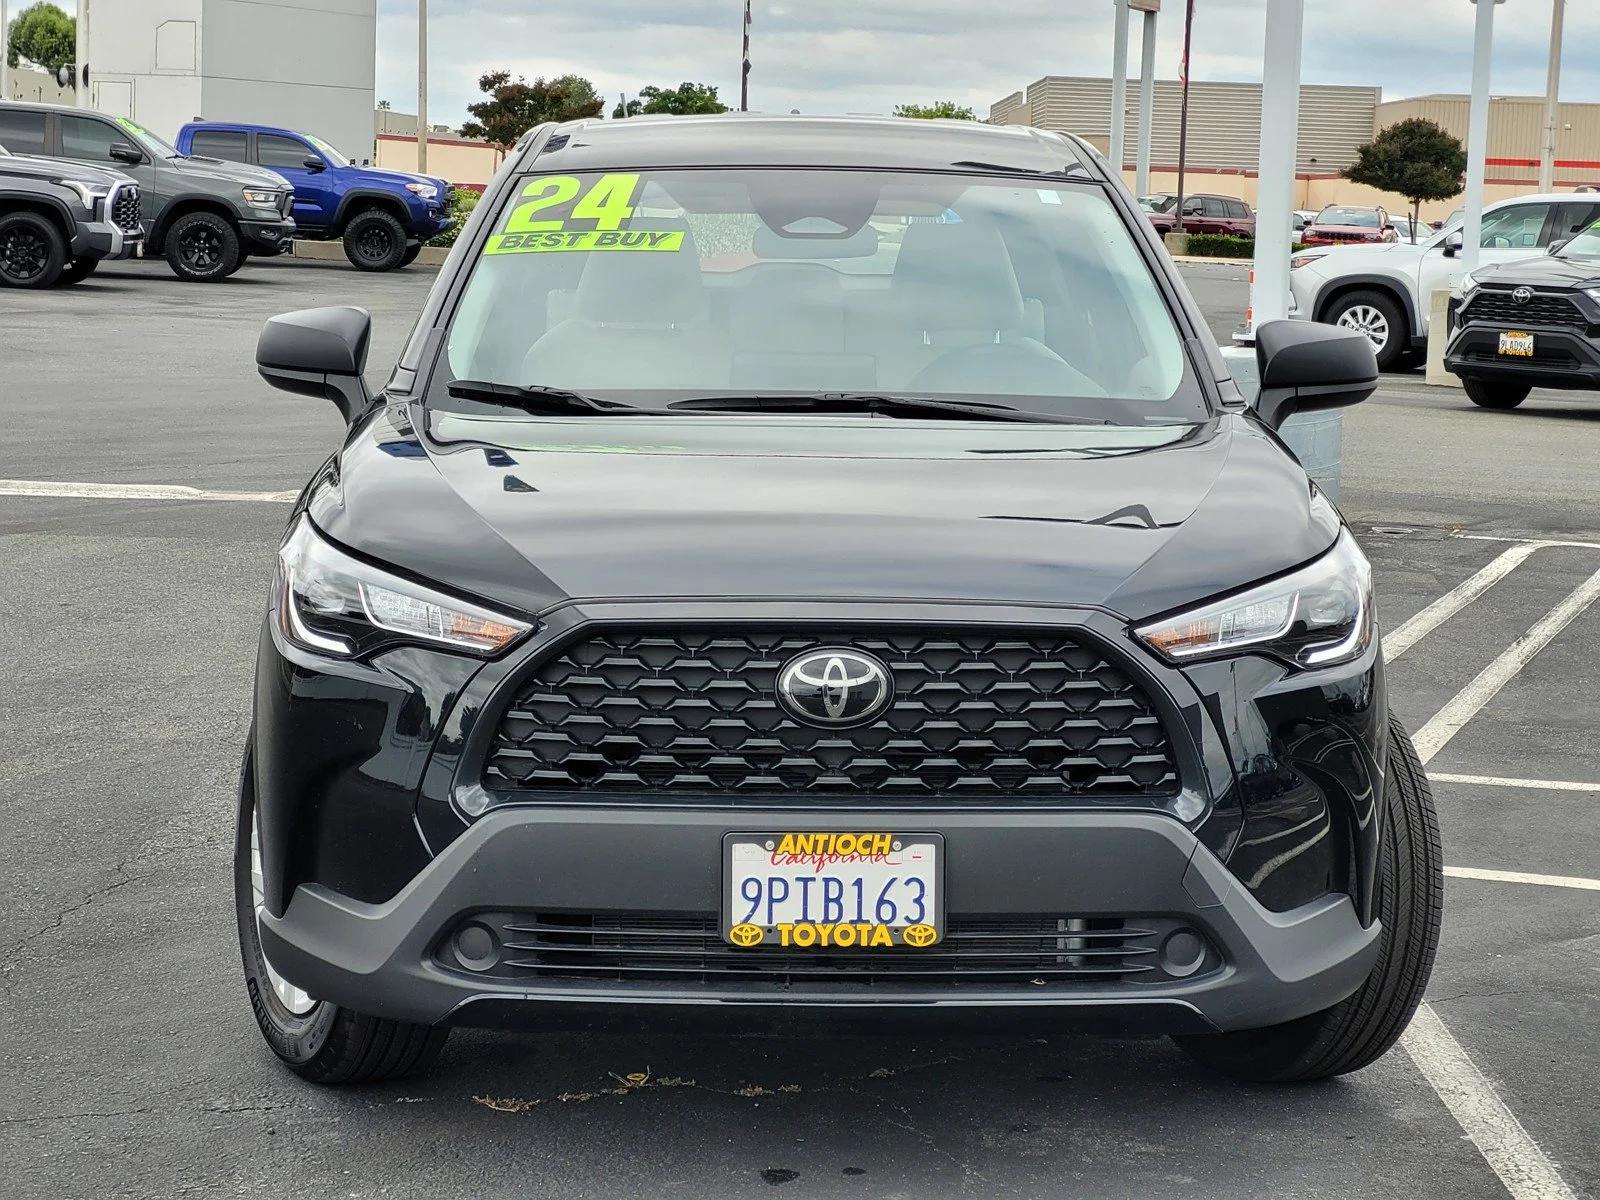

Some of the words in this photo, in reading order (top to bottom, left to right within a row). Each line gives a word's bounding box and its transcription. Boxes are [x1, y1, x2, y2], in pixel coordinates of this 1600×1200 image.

[504, 174, 640, 233] 24
[497, 233, 590, 250] BEST
[594, 232, 673, 248] BUY
[776, 833, 892, 855] ANTIOCH
[740, 877, 926, 925] 9PIB163
[777, 923, 893, 947] TOYOTA
